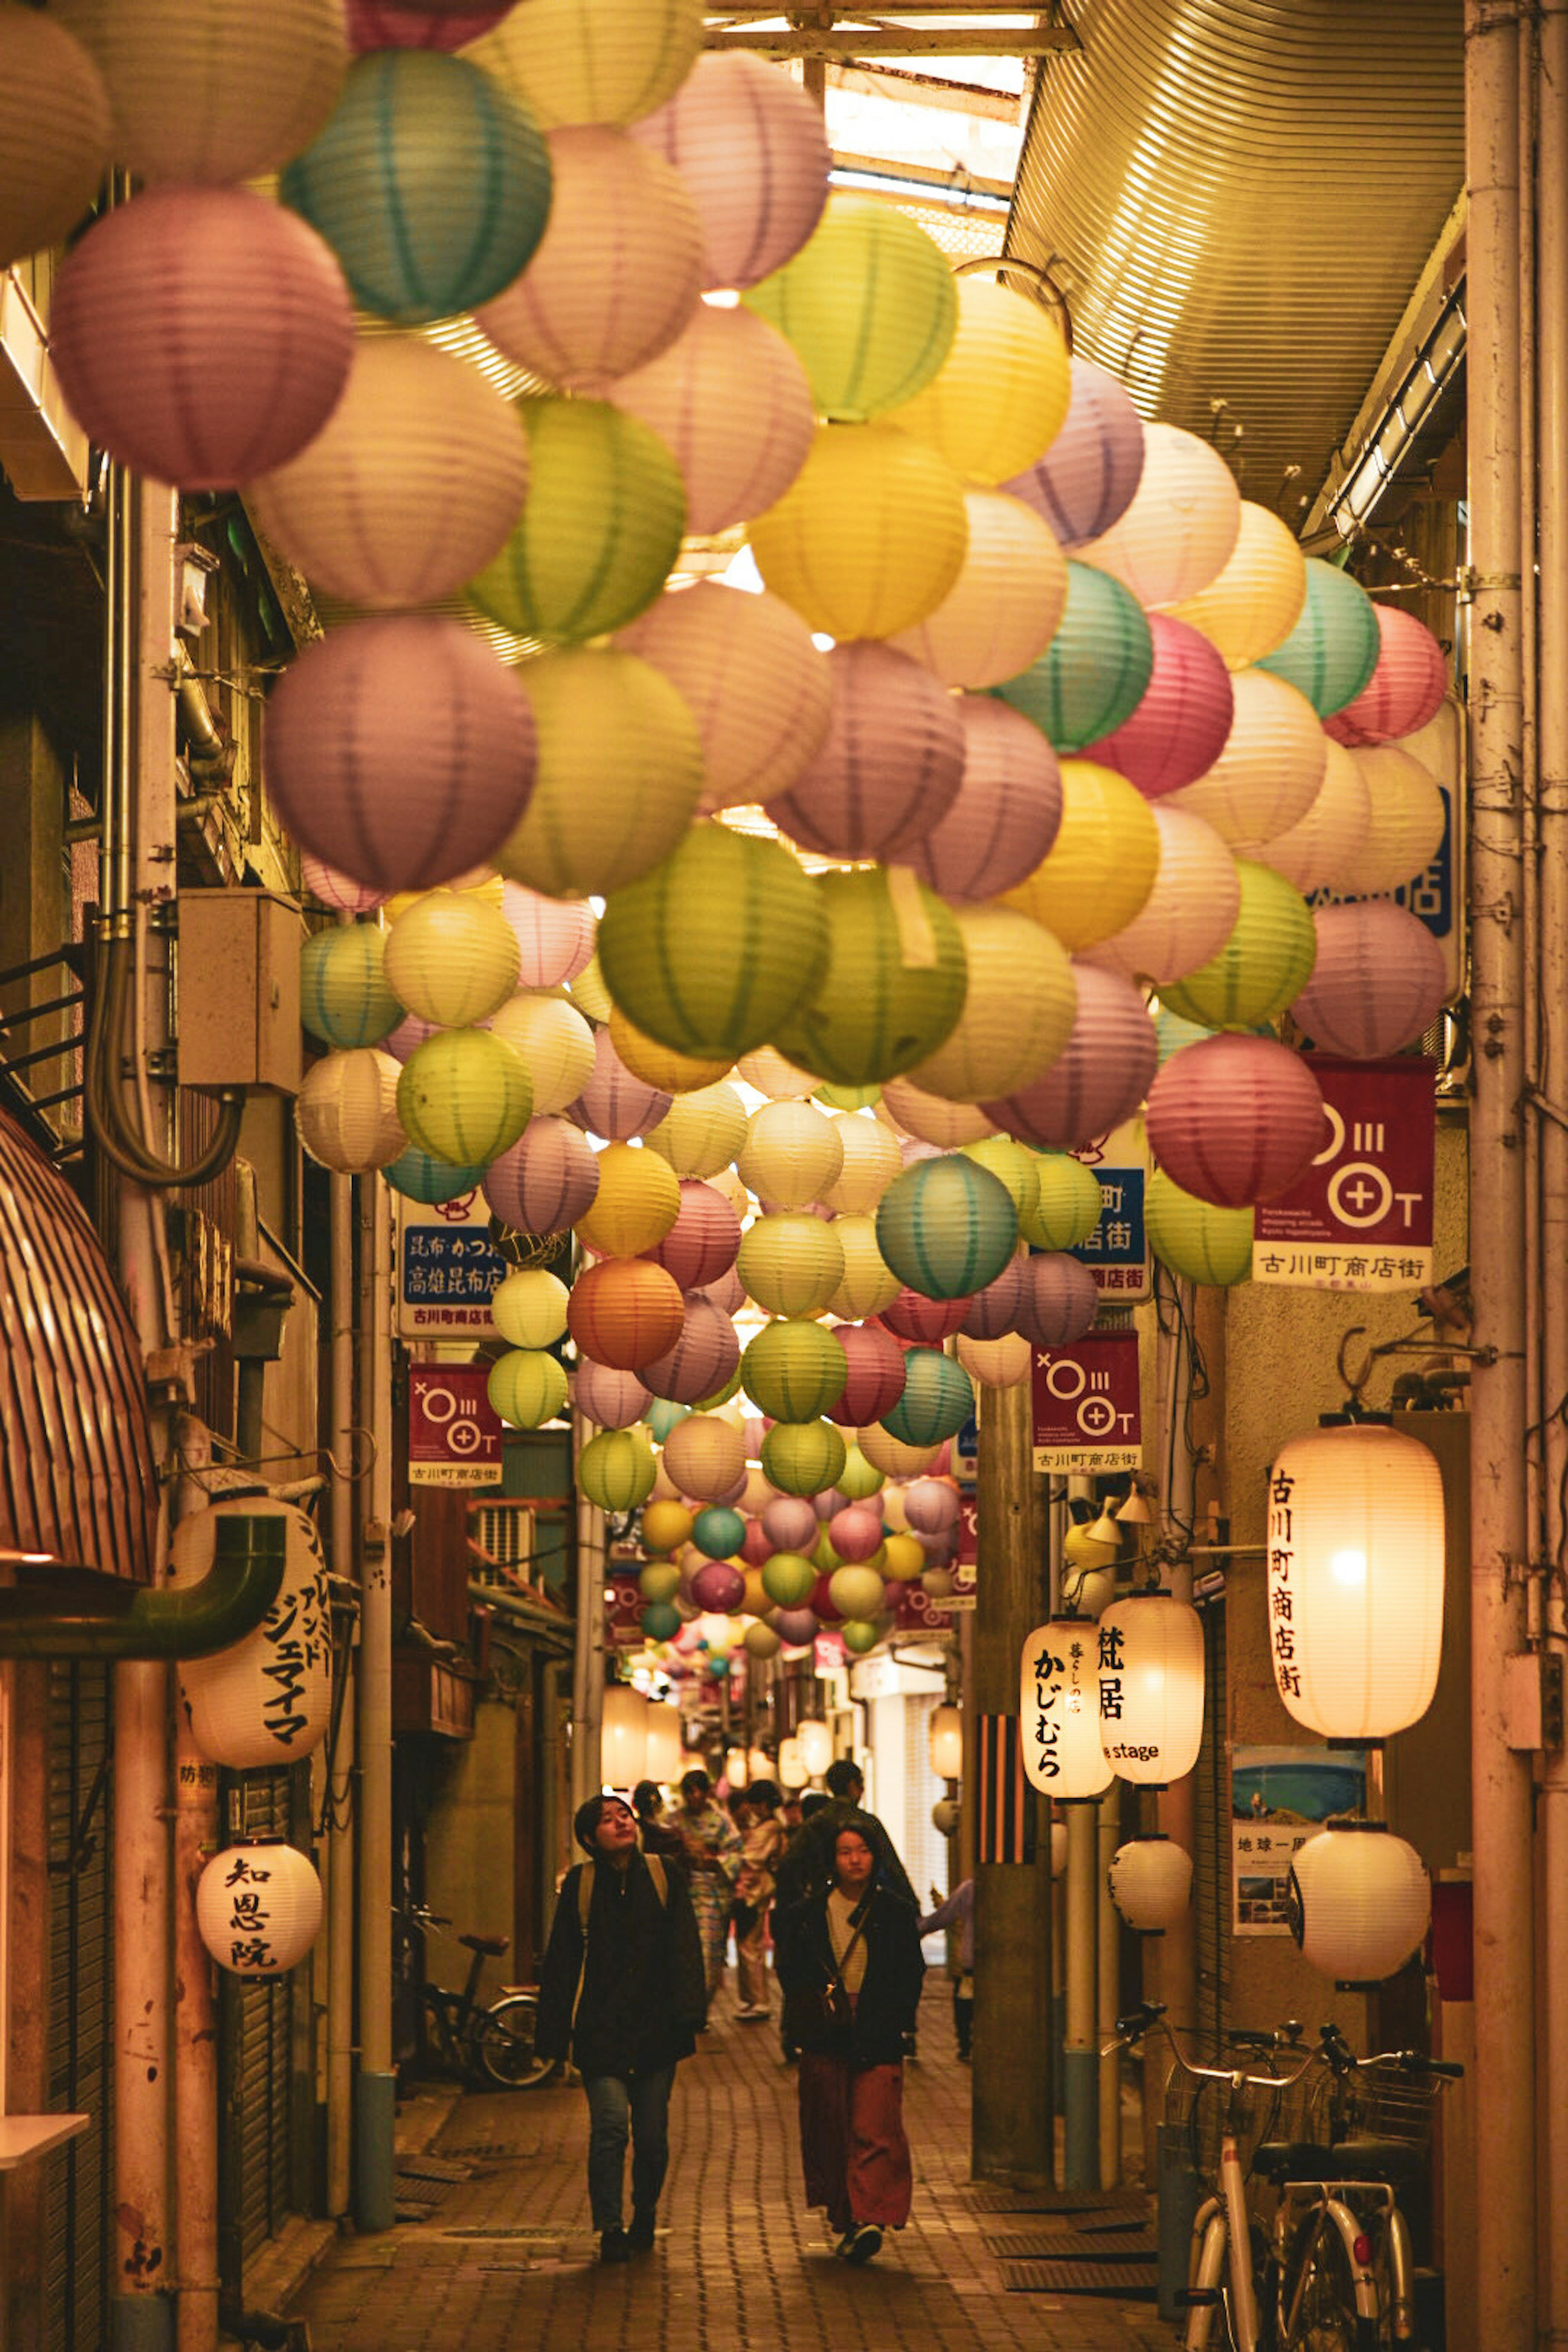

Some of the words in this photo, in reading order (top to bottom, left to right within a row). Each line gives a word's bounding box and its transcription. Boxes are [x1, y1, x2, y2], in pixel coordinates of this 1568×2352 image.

[1260, 1253, 1425, 1279] 古川町商店街
[1038, 1453, 1138, 1467] 古川町商店街
[1271, 1469, 1301, 1699] 古川町商店街
[1034, 1649, 1065, 1777] かじむら
[1112, 1743, 1159, 1761] stage
[225, 1858, 278, 1968] 知恩院
